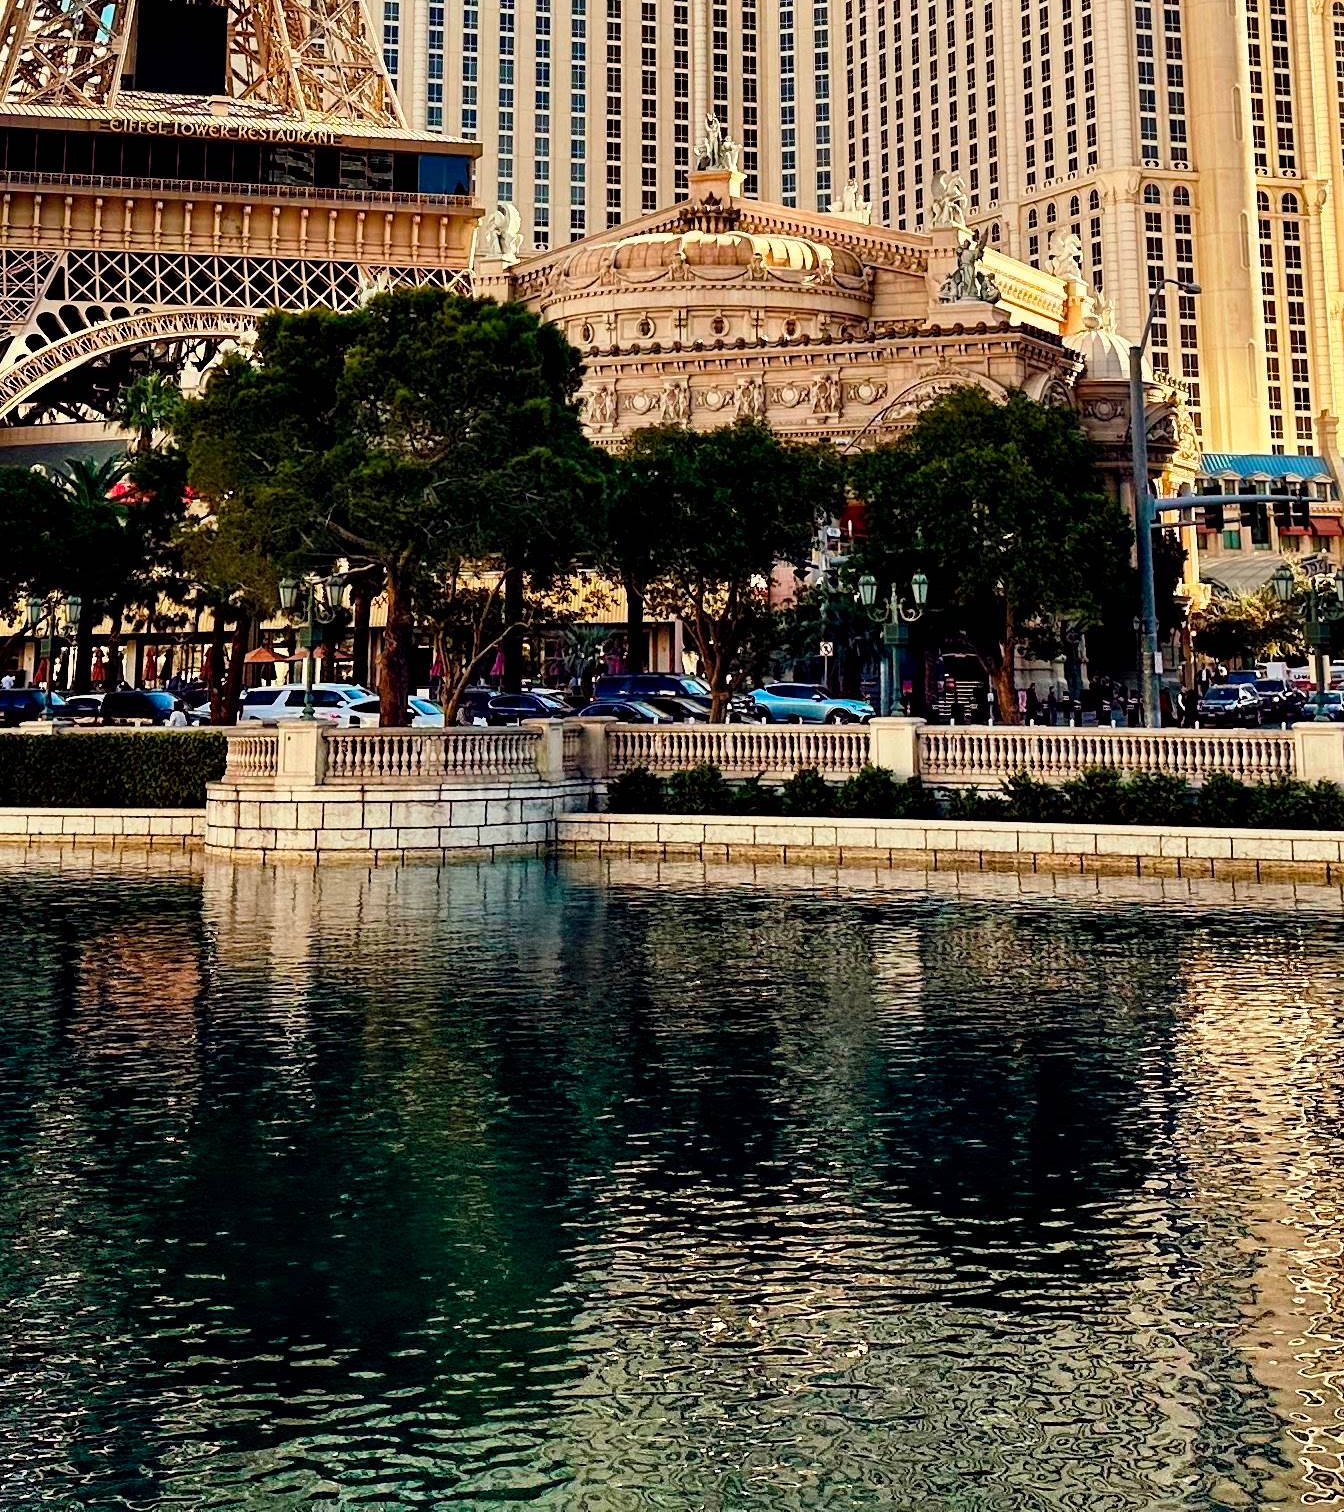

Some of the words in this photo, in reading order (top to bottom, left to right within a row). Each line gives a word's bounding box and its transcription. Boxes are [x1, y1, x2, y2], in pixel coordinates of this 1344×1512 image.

[109, 117, 167, 134] EIFFEL
[172, 120, 229, 138] TOWER
[238, 126, 337, 145] RESTAURANT
